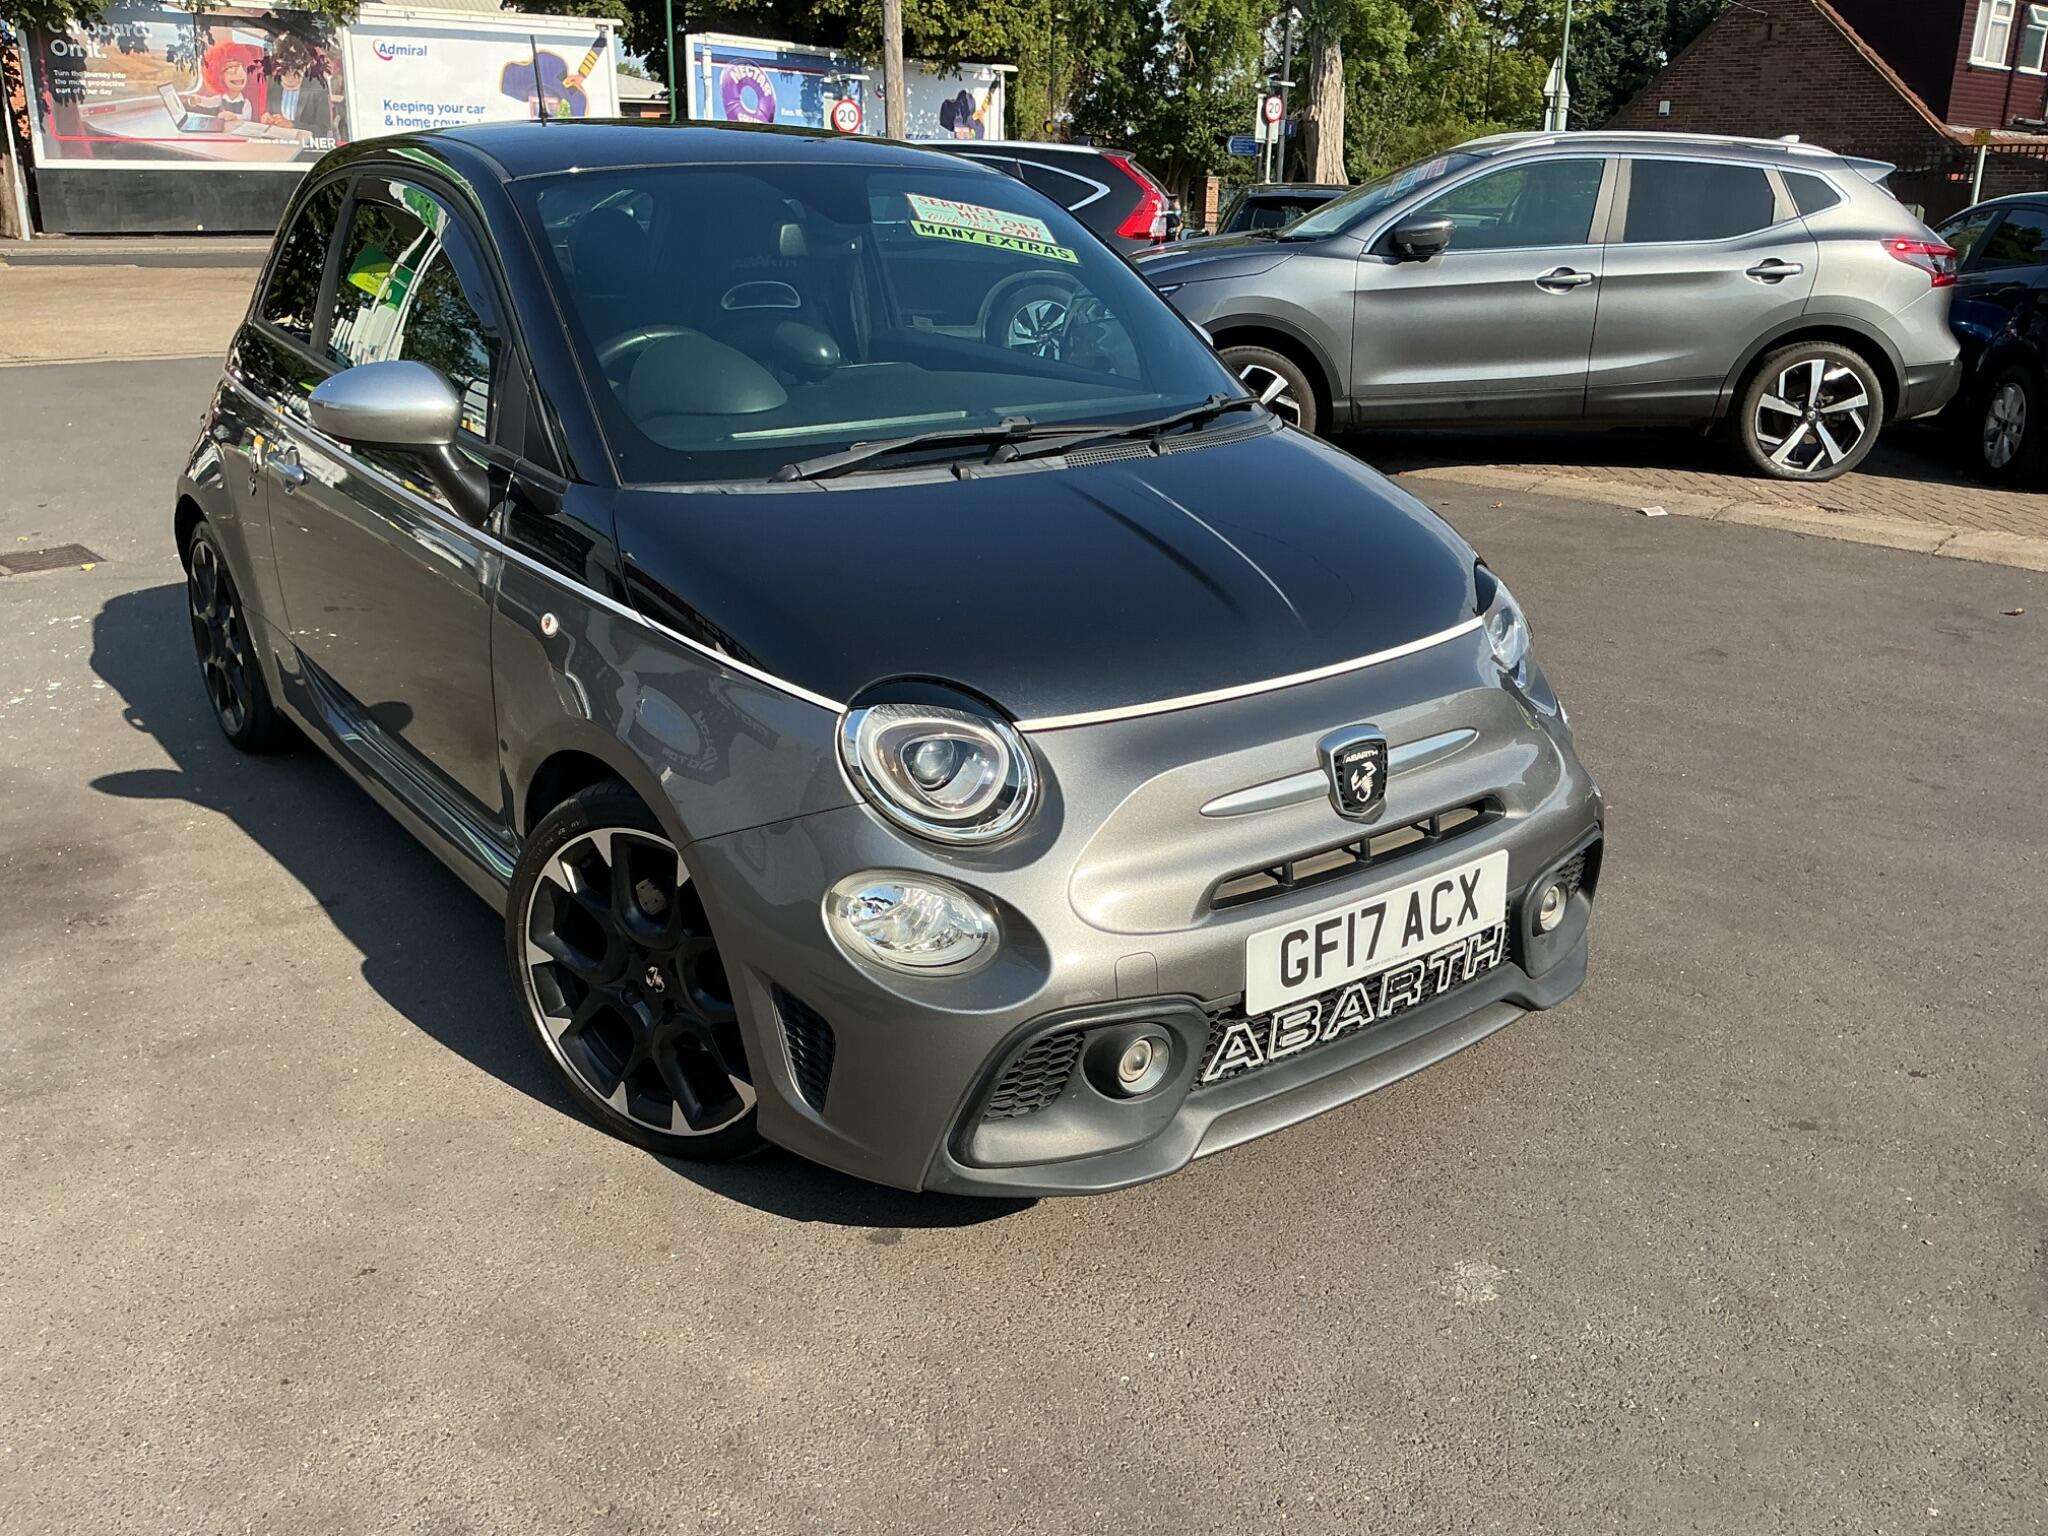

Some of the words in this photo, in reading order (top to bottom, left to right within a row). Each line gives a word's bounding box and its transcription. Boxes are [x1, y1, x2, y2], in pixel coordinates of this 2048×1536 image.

[50, 39, 83, 57] On
[379, 43, 428, 57] Admiral
[383, 99, 434, 115] Keeping
[437, 103, 464, 115] your
[466, 105, 486, 114] car
[838, 104, 857, 123] 20
[1268, 102, 1281, 114] 20
[384, 114, 394, 127] &
[396, 114, 431, 128] home
[302, 136, 336, 150] LNER
[919, 223, 977, 241] MANY
[985, 236, 1070, 259] EXTRAS
[1279, 902, 1388, 989] GF17
[1400, 867, 1483, 949] ACX
[1202, 921, 1507, 1083] ABARTH
